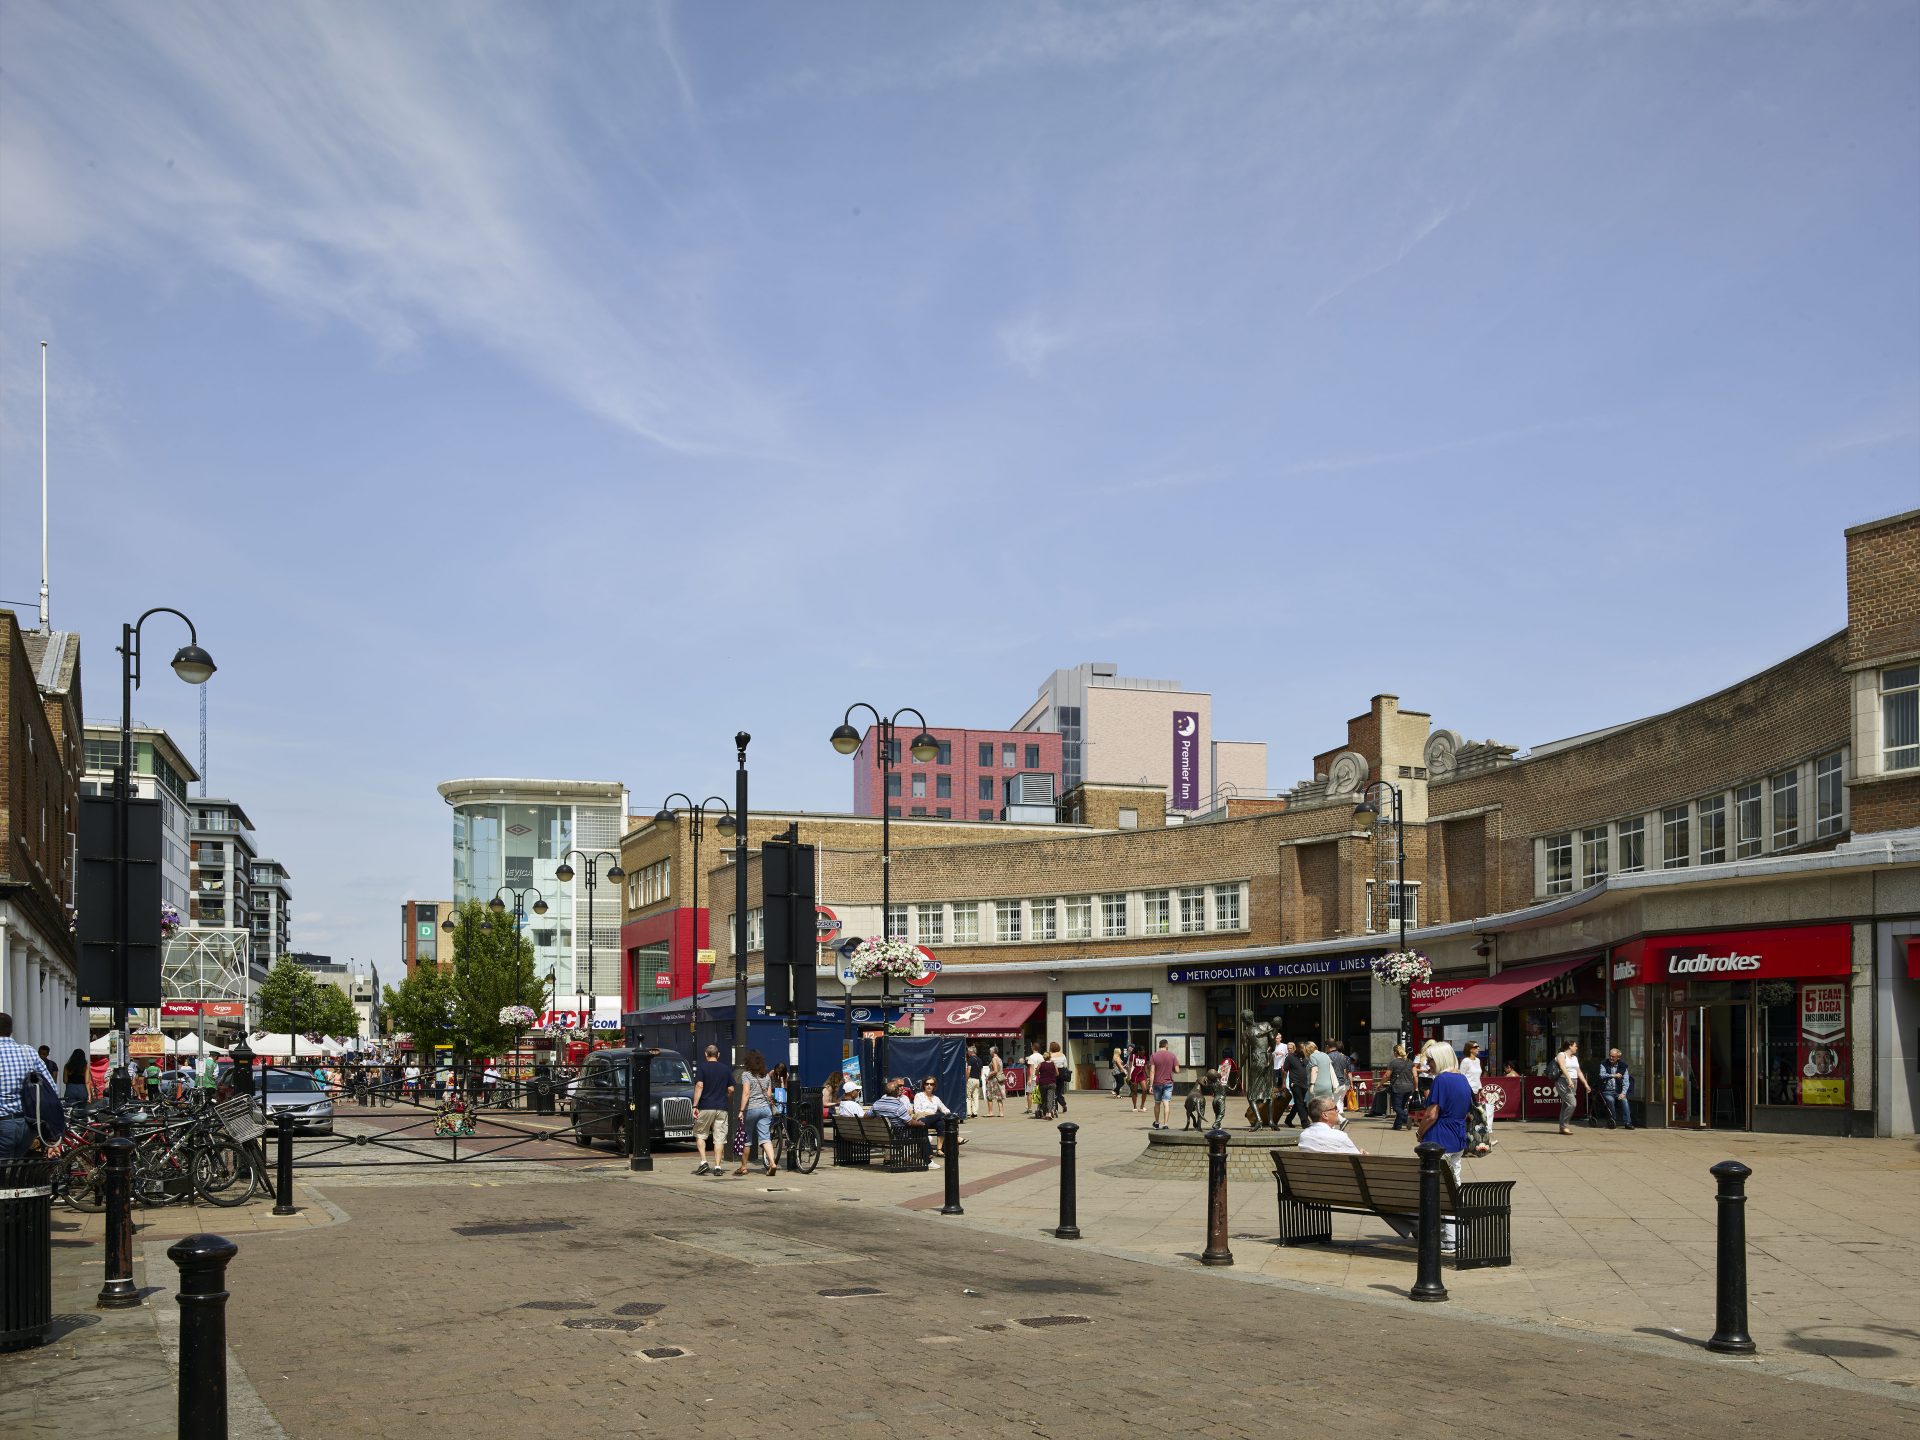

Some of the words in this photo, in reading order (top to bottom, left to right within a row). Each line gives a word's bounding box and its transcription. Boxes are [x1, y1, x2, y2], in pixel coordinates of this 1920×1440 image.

[1181, 740, 1191, 784] Premier
[1181, 783, 1190, 800] Inn
[422, 926, 431, 936] D
[1668, 951, 1762, 974] Ladbrokes
[1186, 967, 1256, 981] METROPOLITAN
[1264, 966, 1271, 976] &
[1278, 961, 1331, 975] PICCADILLY
[1340, 958, 1366, 971] LINES
[1260, 982, 1320, 999] UXBRIDG
[1411, 987, 1434, 1000] Sweet
[1805, 989, 1817, 1013] 5
[1817, 988, 1842, 1000] TEAM
[213, 1004, 232, 1012] Argos
[1110, 1003, 1122, 1011] TUI
[1817, 1001, 1842, 1013] ACCA
[1804, 1013, 1842, 1022] INSURANCE
[1482, 1083, 1502, 1094] COSTA
[1533, 1086, 1559, 1097] COS
